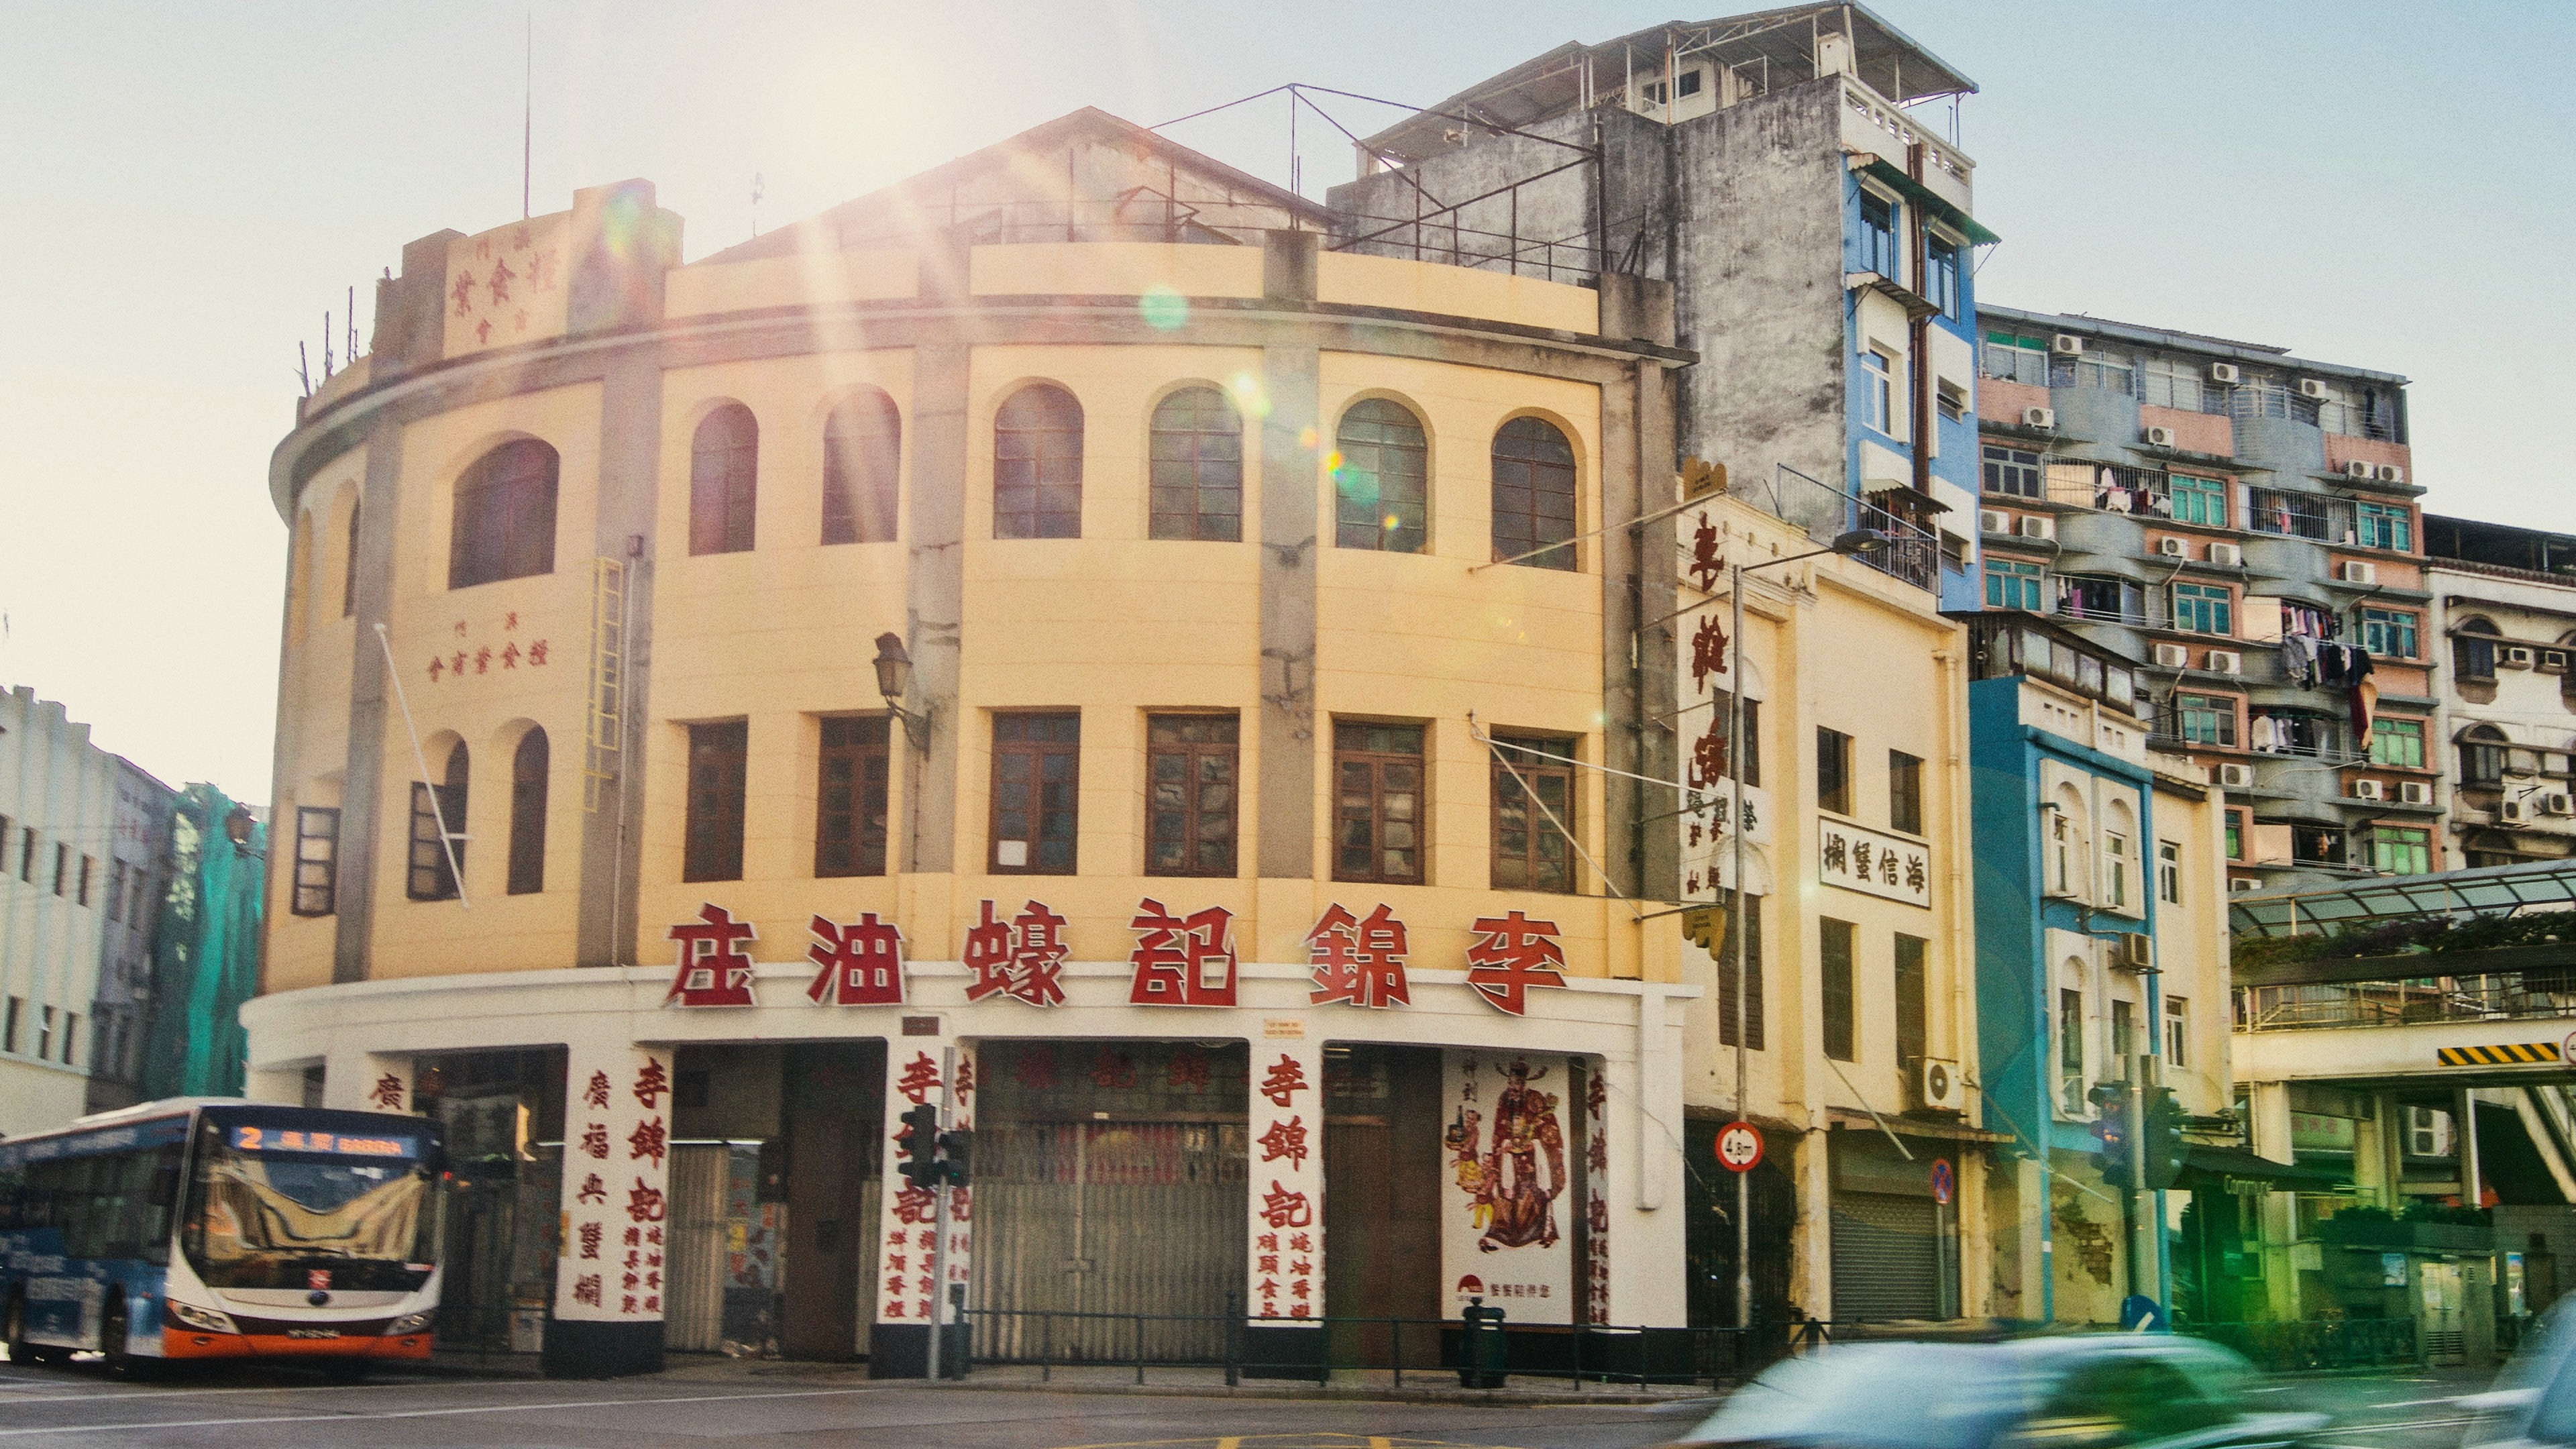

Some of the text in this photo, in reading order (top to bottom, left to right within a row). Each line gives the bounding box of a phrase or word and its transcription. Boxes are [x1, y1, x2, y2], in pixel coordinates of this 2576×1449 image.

[239, 1126, 263, 1150] 2
[627, 1055, 669, 1223] 李錦記
[1257, 1053, 1313, 1230] 李錦記
